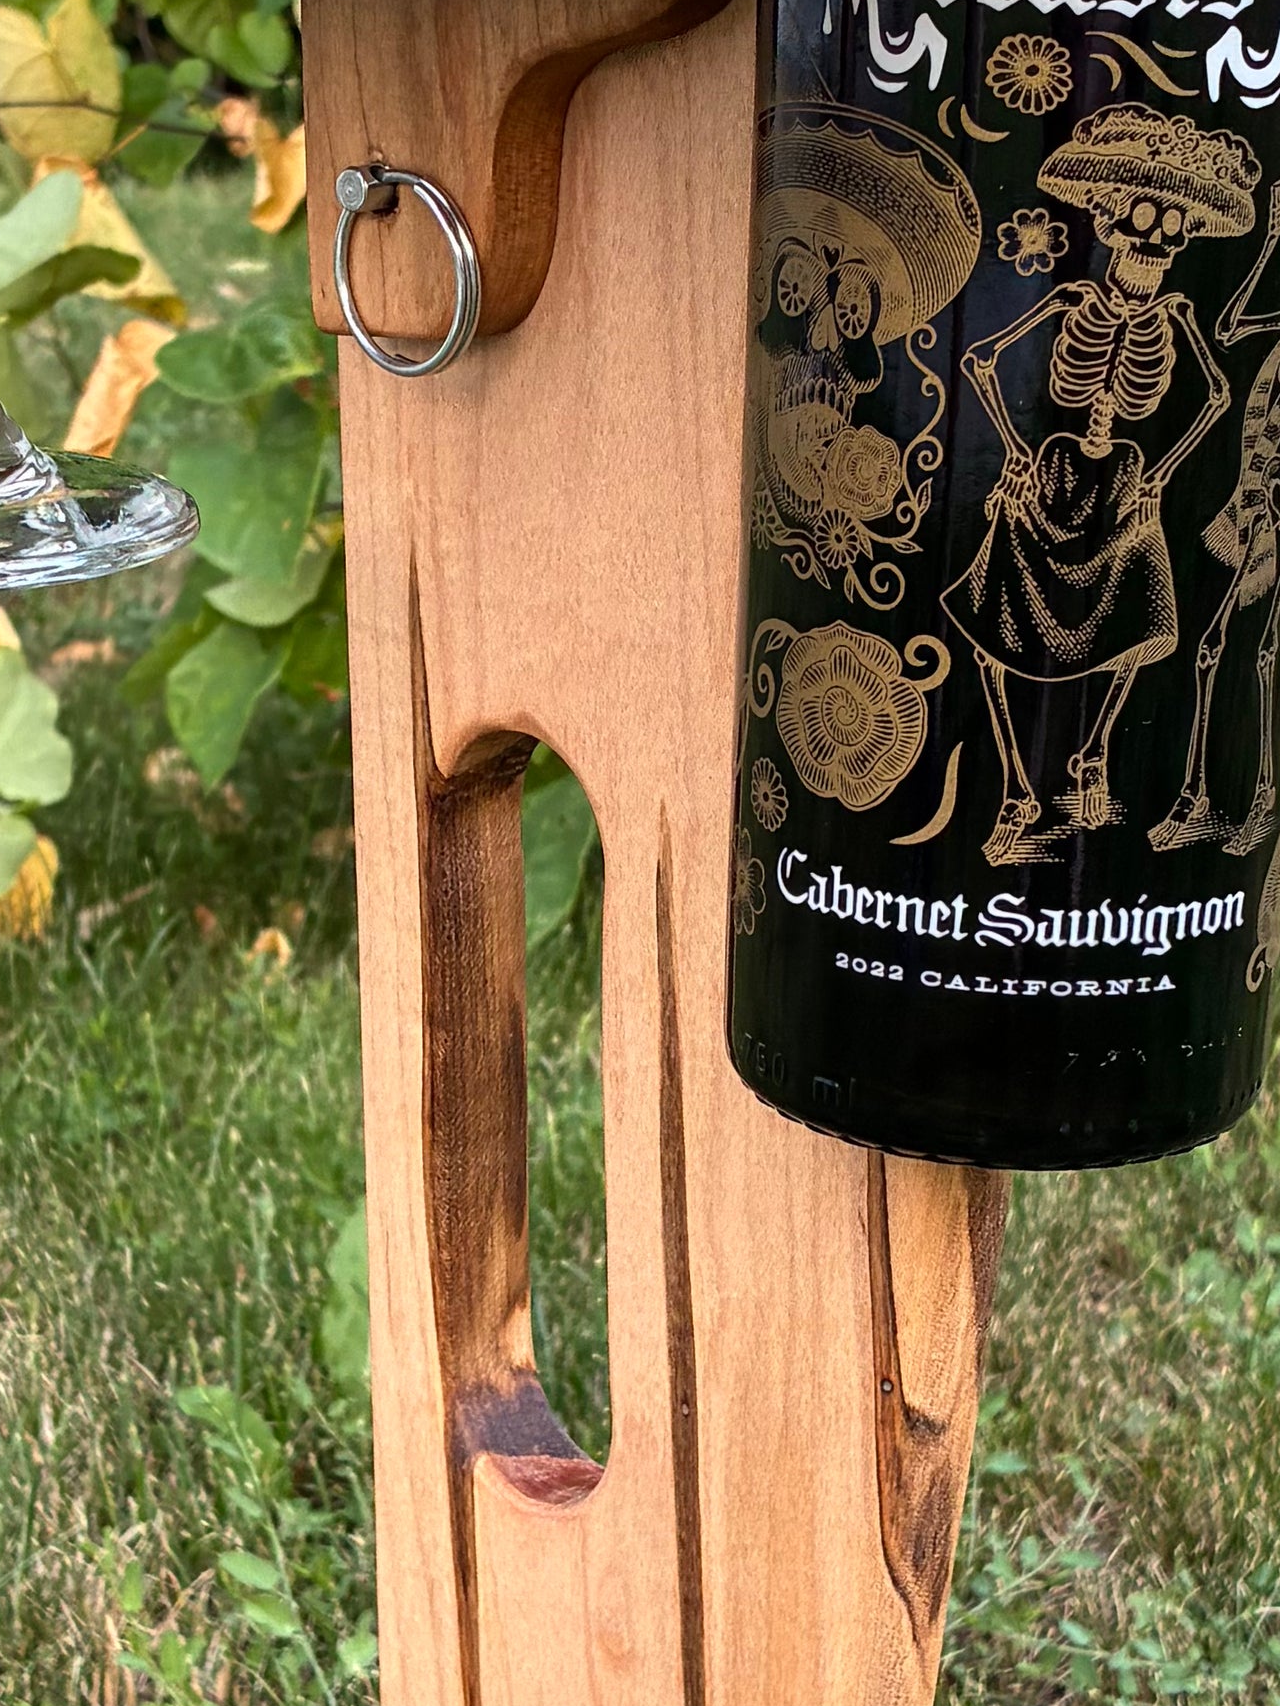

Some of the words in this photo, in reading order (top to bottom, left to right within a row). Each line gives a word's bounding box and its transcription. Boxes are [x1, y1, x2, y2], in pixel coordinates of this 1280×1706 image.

[777, 846, 970, 941] Cabernet
[974, 890, 1245, 956] Sauvignon
[834, 951, 905, 982] 2022
[919, 970, 1177, 997] CALIFORNIA
